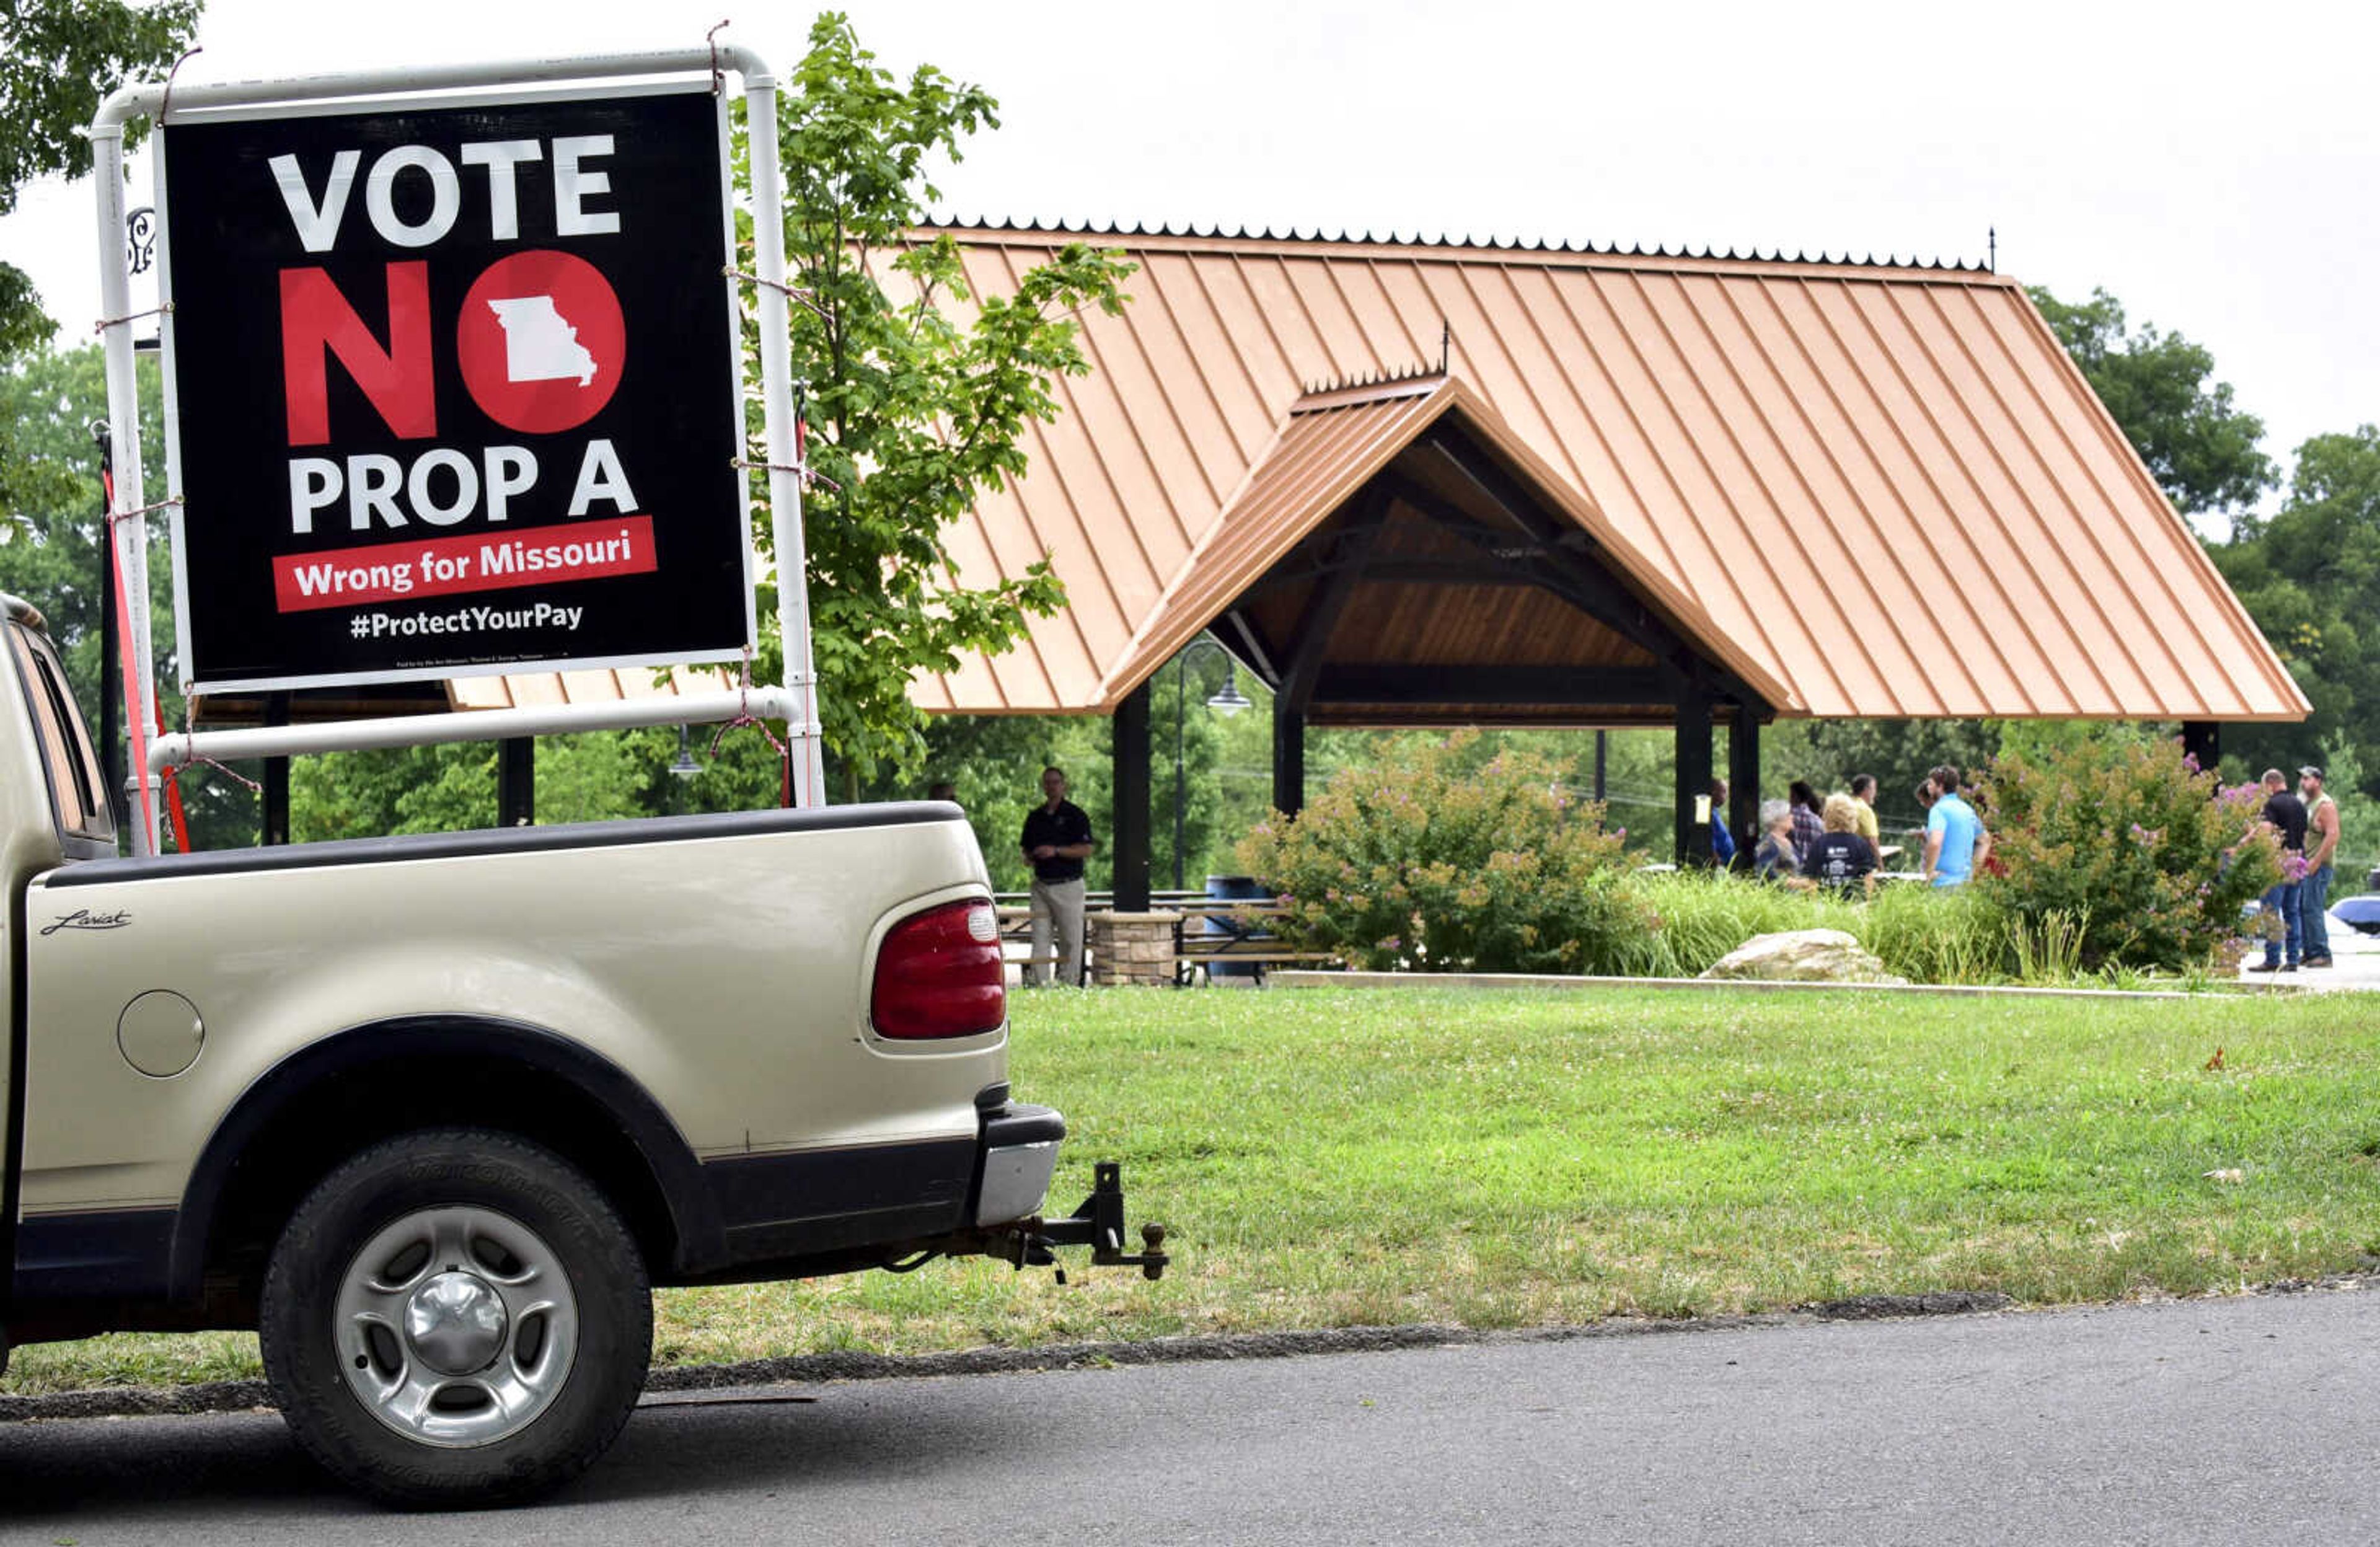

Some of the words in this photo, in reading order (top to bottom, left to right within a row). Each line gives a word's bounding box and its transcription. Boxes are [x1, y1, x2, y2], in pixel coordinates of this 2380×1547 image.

[268, 134, 620, 253] VOTE
[280, 250, 626, 446] NO
[289, 446, 539, 534] PROP
[568, 439, 639, 516] A
[293, 563, 413, 596] Wrong
[419, 551, 470, 583] for
[480, 529, 632, 576] Missouri
[351, 603, 583, 638] #ProtectYourPay
[40, 909, 131, 935] Lariat
